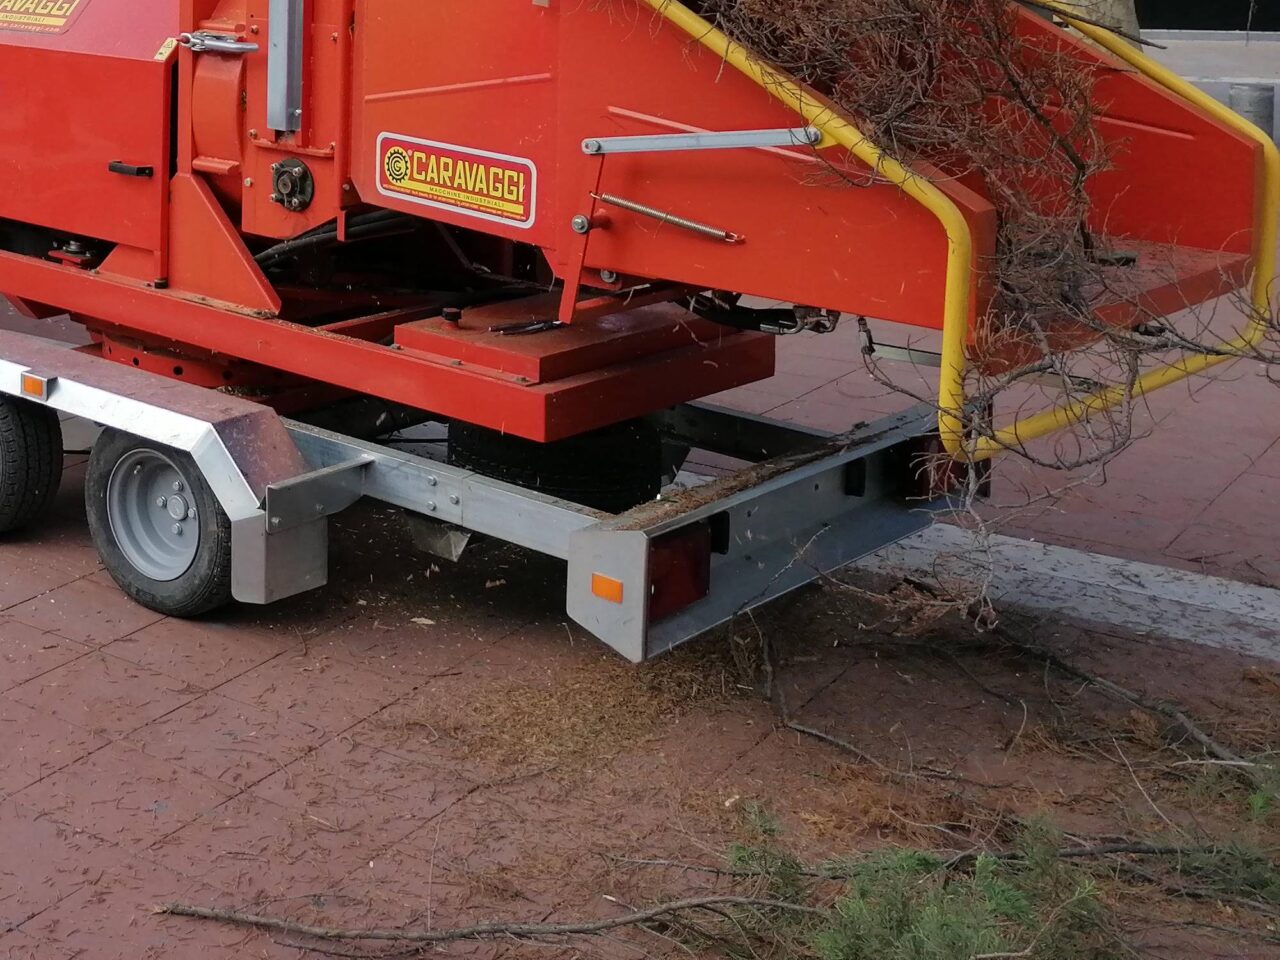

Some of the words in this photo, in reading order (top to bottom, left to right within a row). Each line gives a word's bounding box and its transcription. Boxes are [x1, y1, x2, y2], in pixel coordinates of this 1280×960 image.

[2, 13, 46, 23] INDUSTRIALI
[412, 150, 524, 202] CARAVAGGI
[429, 186, 462, 200] MACCHINE
[463, 193, 505, 208] INDUSTRIALI
